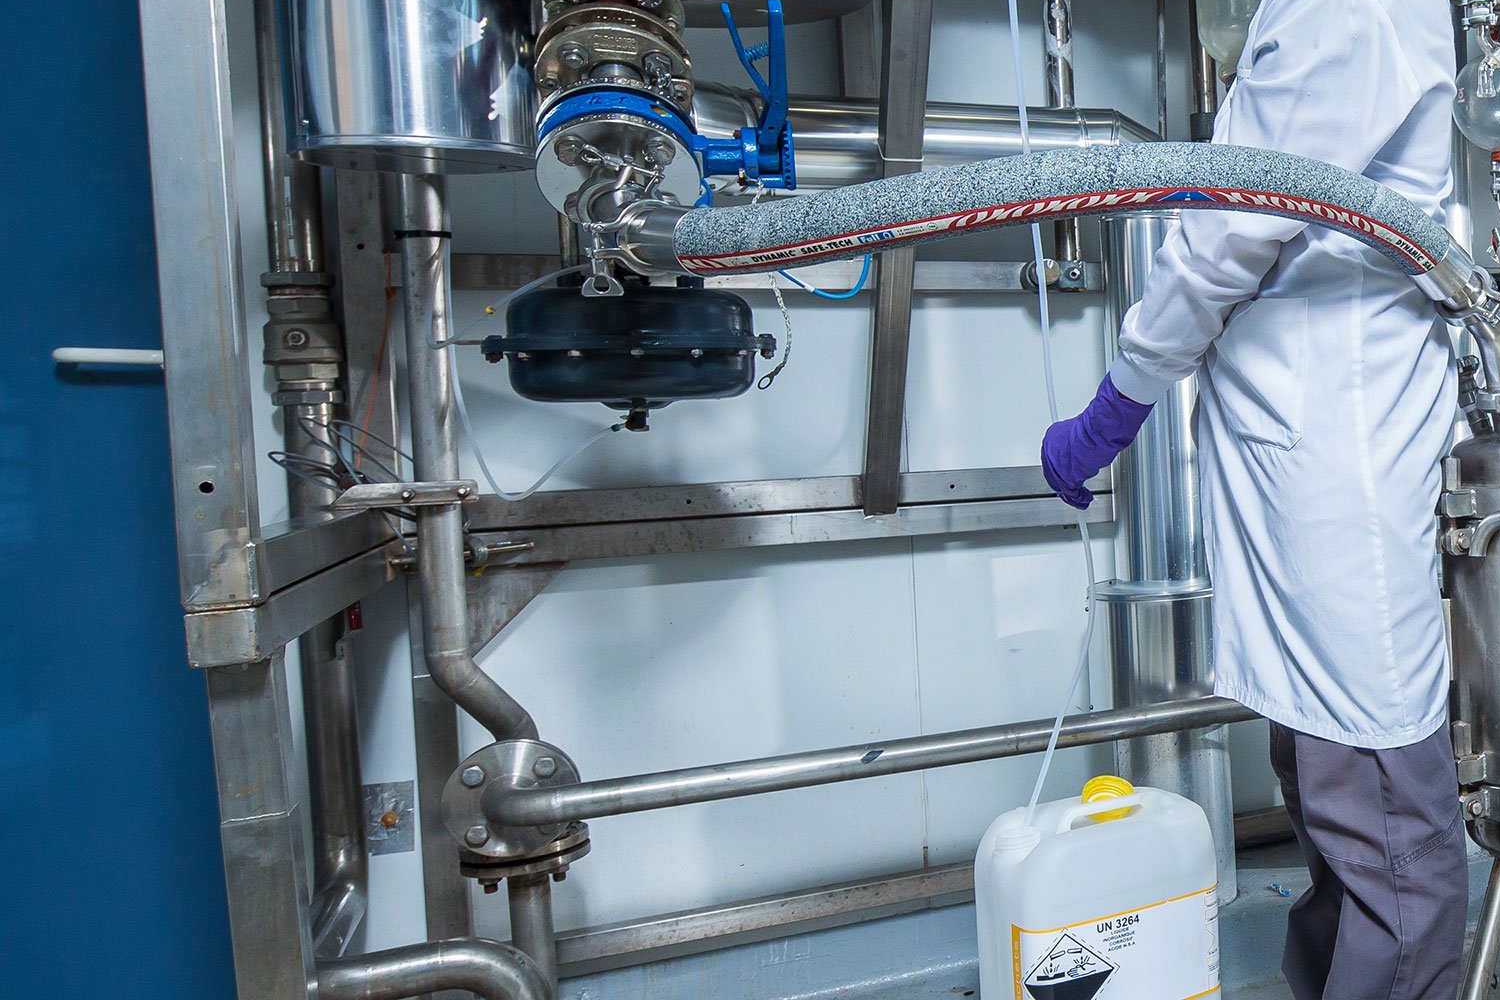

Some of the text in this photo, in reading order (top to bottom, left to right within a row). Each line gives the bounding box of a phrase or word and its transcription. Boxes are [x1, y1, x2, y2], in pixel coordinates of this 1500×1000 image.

[800, 238, 853, 255] SAFE-TECH
[1096, 913, 1140, 934] UN 3264
[1103, 930, 1136, 943] INORGANIQUE
[1110, 926, 1129, 936] LIQUIDE
[1109, 936, 1134, 947] CORROSIF
[1107, 944, 1122, 953] ACIDE
